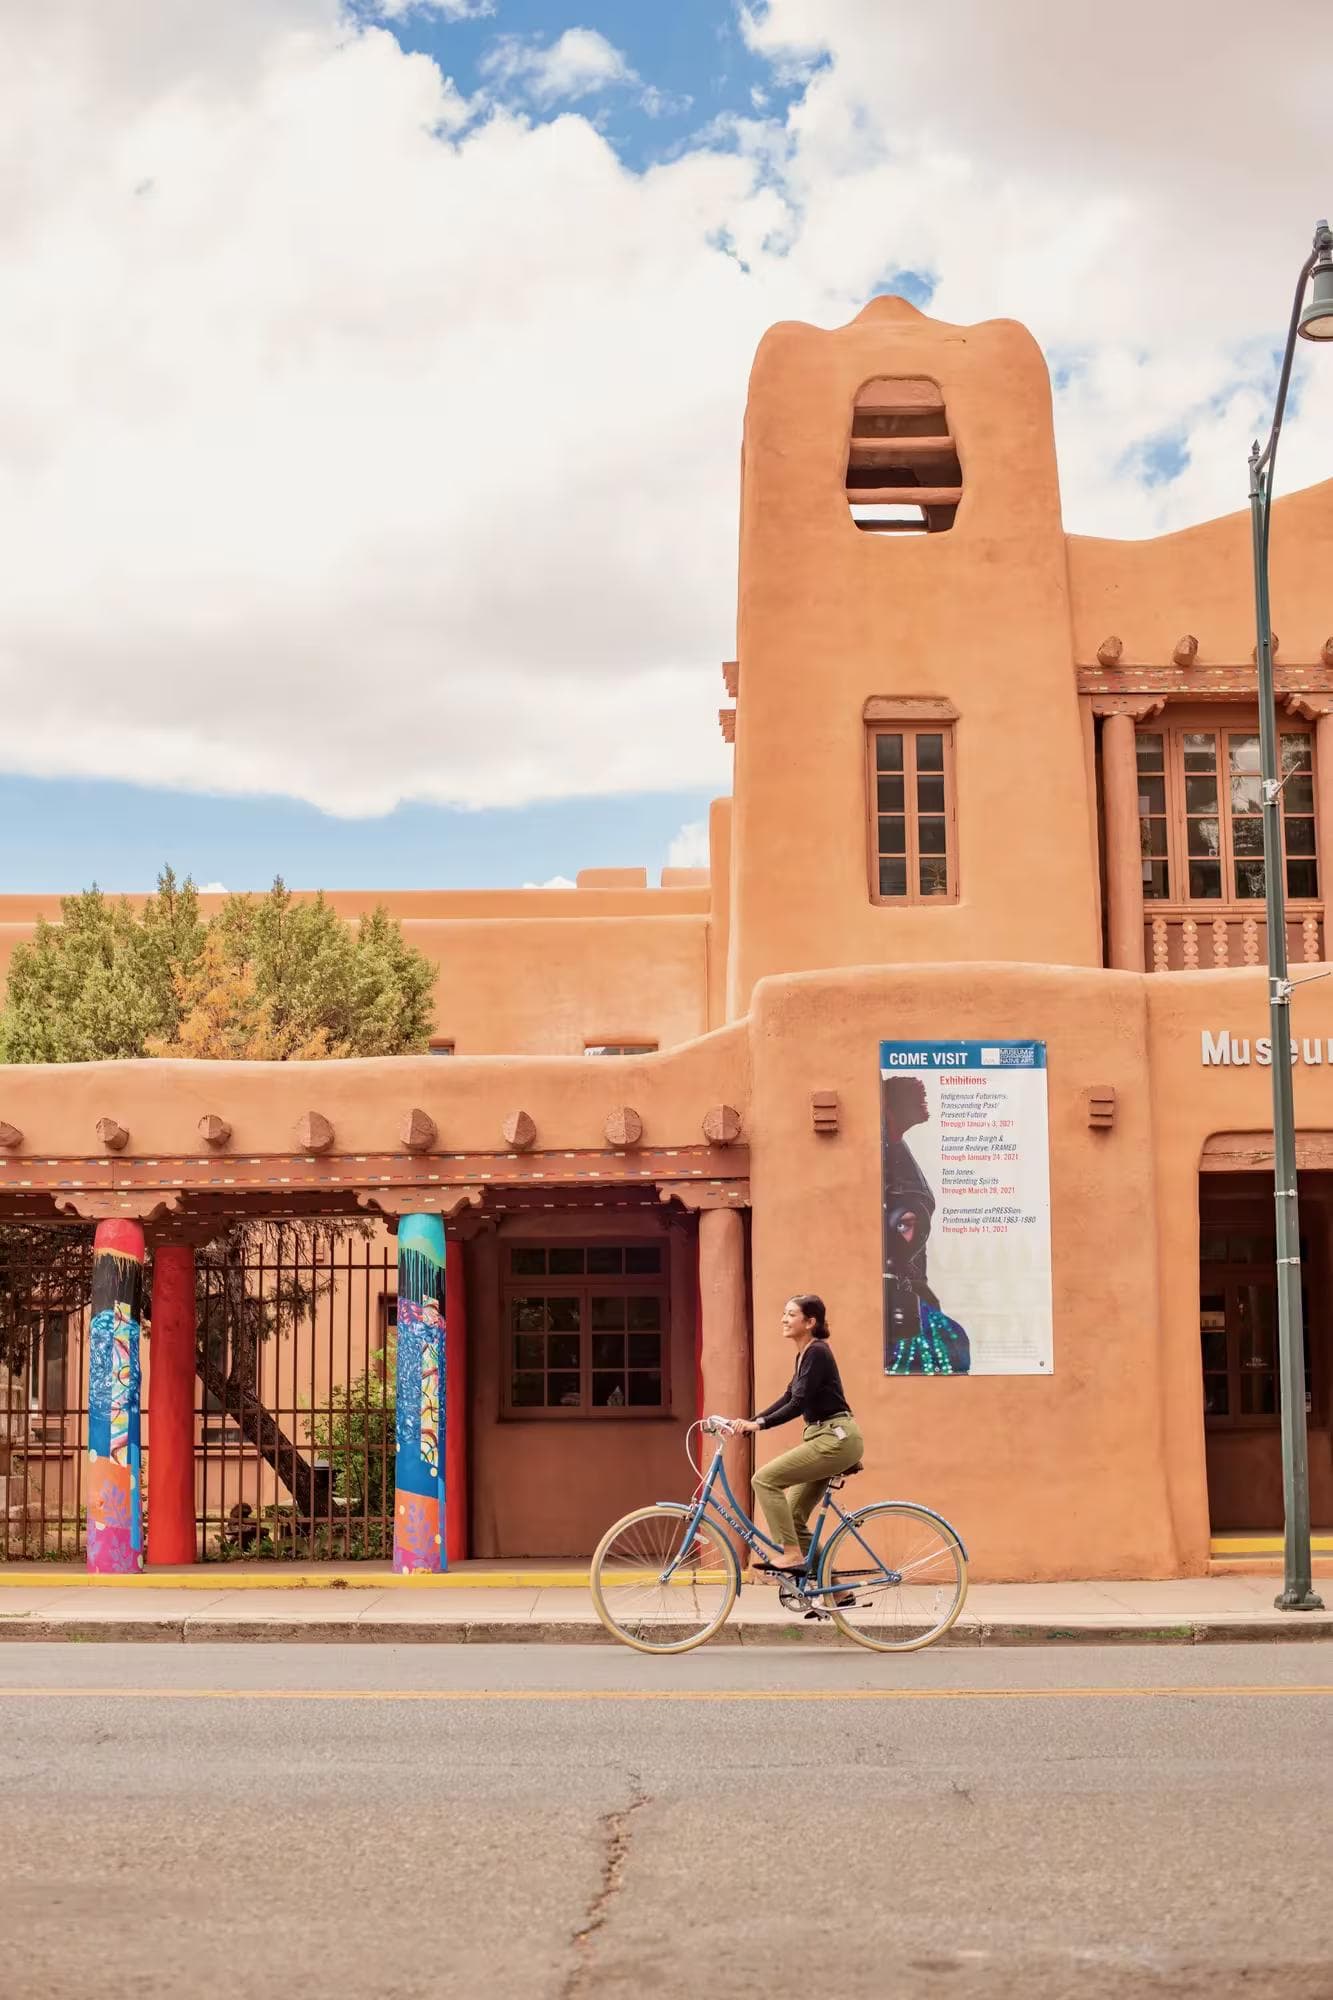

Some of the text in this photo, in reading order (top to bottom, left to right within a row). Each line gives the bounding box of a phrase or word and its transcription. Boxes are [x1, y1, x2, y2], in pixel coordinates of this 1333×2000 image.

[1201, 1030, 1333, 1066] Musu
[889, 1052, 929, 1066] COME
[932, 1052, 968, 1066] VISIT
[939, 1075, 987, 1086] Exhibitions
[940, 1120, 966, 1129] Through
[967, 1120, 990, 1129] January
[999, 1120, 1014, 1128] 2021
[998, 1135, 1004, 1143] &
[990, 1144, 1017, 1152] FRAMED
[941, 1153, 967, 1162] Through
[967, 1153, 991, 1162] January
[1003, 1153, 1019, 1161] 2021
[942, 1168, 955, 1176] Tom
[942, 1177, 999, 1186] Unrelenting Spirits
[942, 1187, 967, 1195] Through
[942, 1207, 983, 1216] Experimental
[942, 1216, 981, 1225] Printmaking
[942, 1226, 968, 1234] Through
[968, 1226, 980, 1234] July
